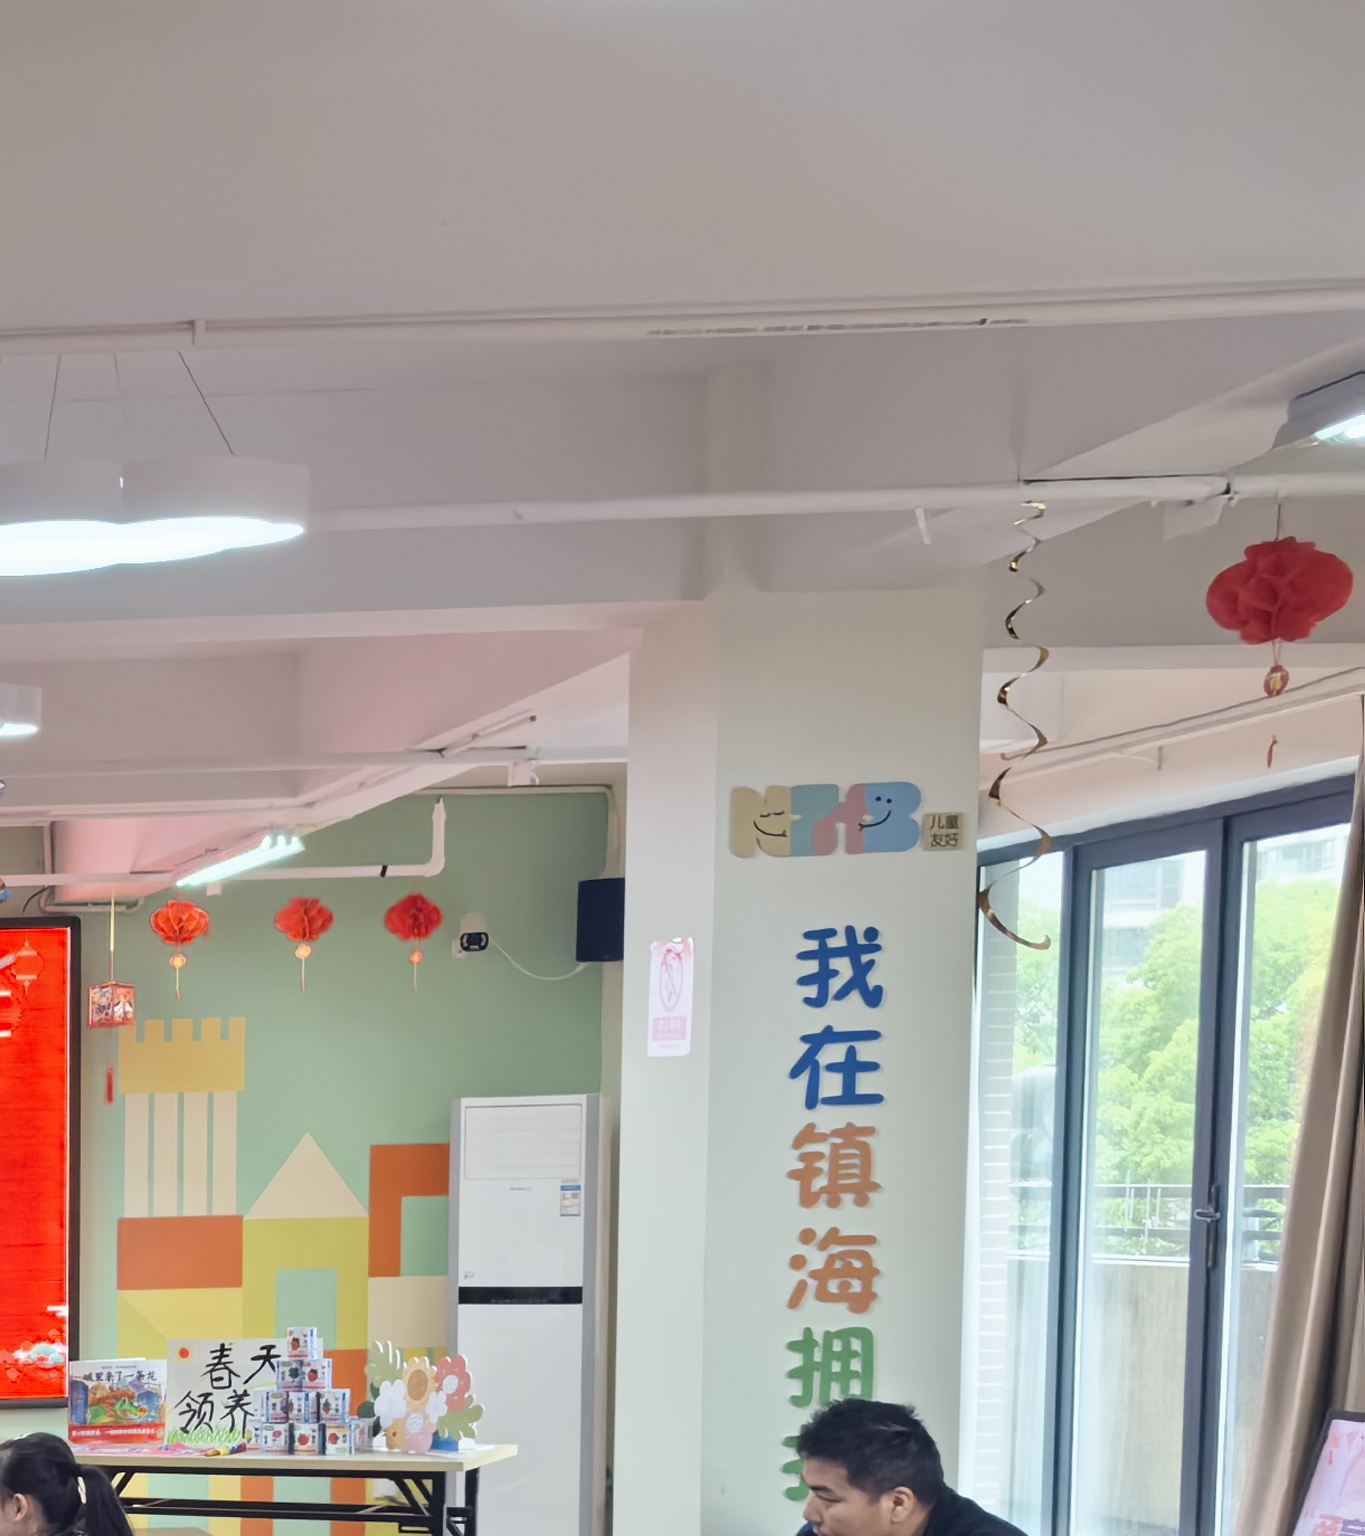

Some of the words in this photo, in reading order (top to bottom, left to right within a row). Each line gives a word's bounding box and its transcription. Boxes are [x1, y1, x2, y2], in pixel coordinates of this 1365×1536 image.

[929, 814, 960, 831] 儿童
[929, 832, 960, 849] 友好
[781, 925, 885, 1502] 我在镇海拥
[200, 1342, 281, 1390] 春天
[174, 1389, 255, 1438] 领养
